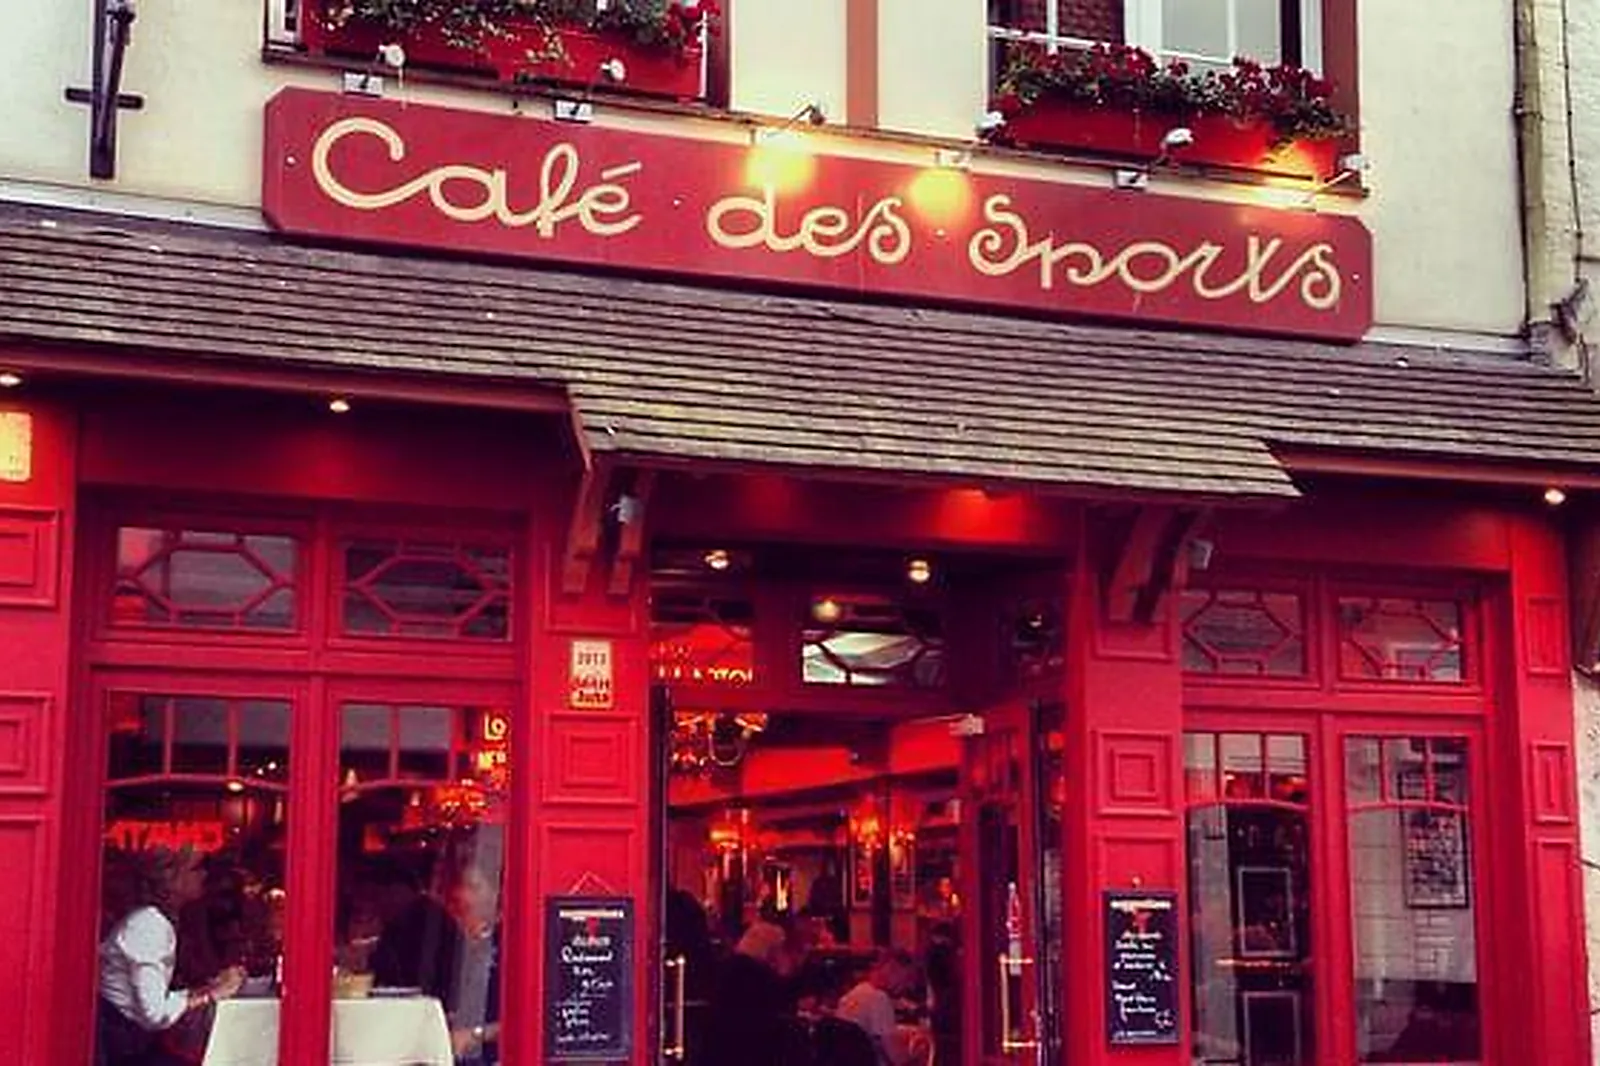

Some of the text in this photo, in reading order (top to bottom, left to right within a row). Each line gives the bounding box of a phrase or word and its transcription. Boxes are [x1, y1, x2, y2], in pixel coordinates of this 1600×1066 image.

[313, 117, 1341, 309] Café des Sports
